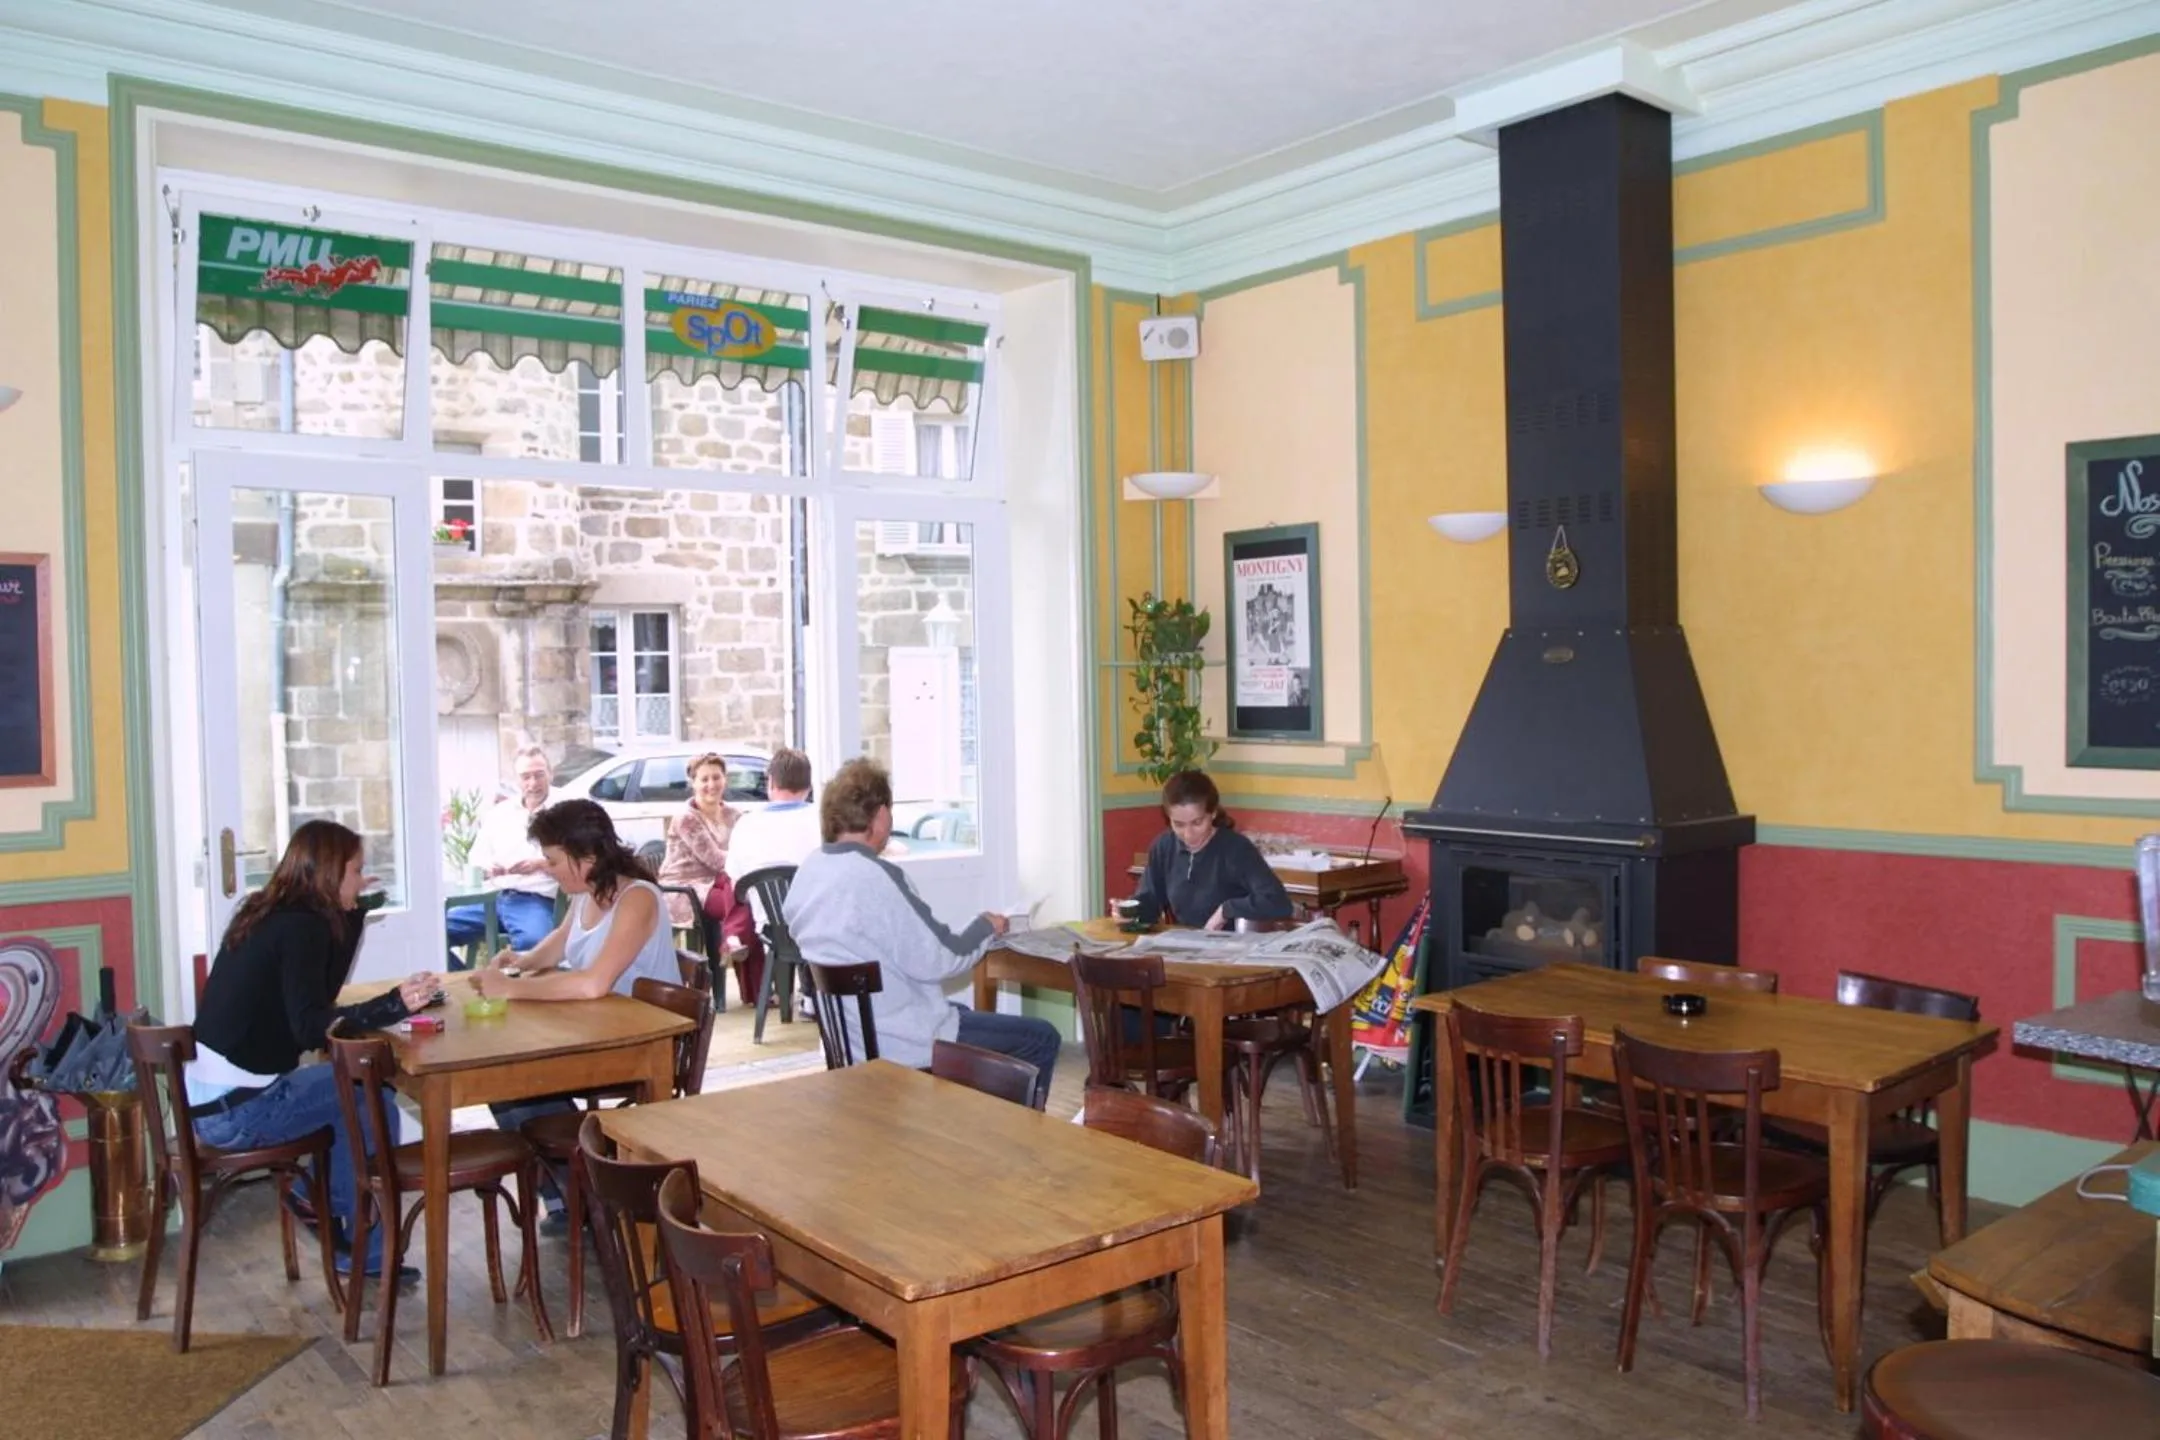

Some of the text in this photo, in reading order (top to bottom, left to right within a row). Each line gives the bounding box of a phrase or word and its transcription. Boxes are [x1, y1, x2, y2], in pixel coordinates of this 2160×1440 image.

[226, 226, 334, 267] PMU
[667, 293, 719, 310] PARIEZ
[1237, 557, 1304, 577] MONTIGNY
